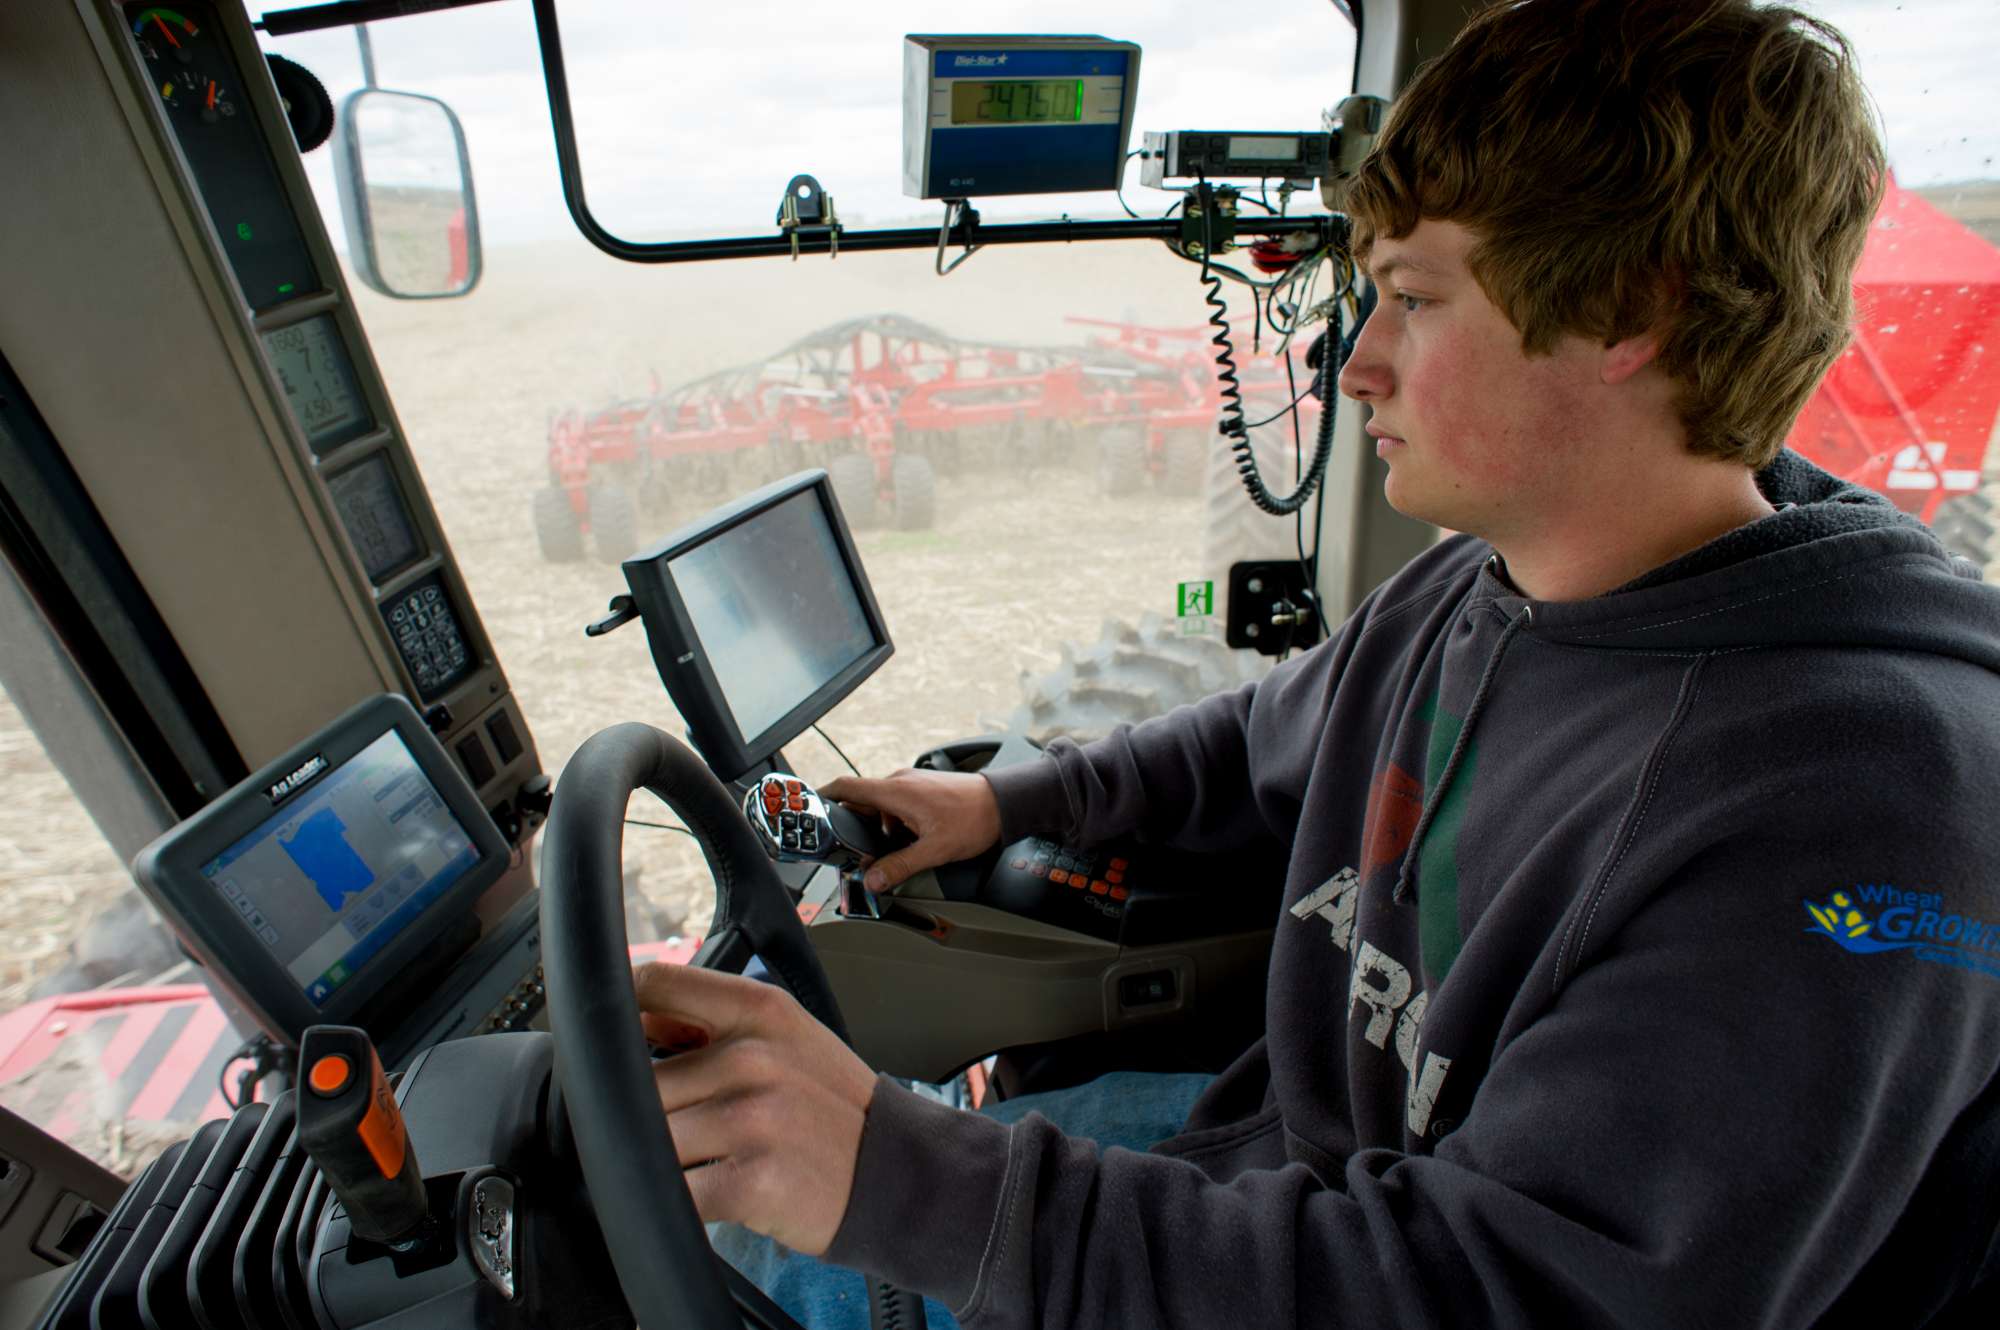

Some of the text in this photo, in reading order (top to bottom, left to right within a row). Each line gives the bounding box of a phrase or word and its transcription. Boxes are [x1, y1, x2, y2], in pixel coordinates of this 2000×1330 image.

[954, 55, 997, 66] Digi-Star
[976, 84, 1070, 119] 24750
[271, 756, 322, 799] Ag Leader
[1856, 884, 1943, 912] Wheat
